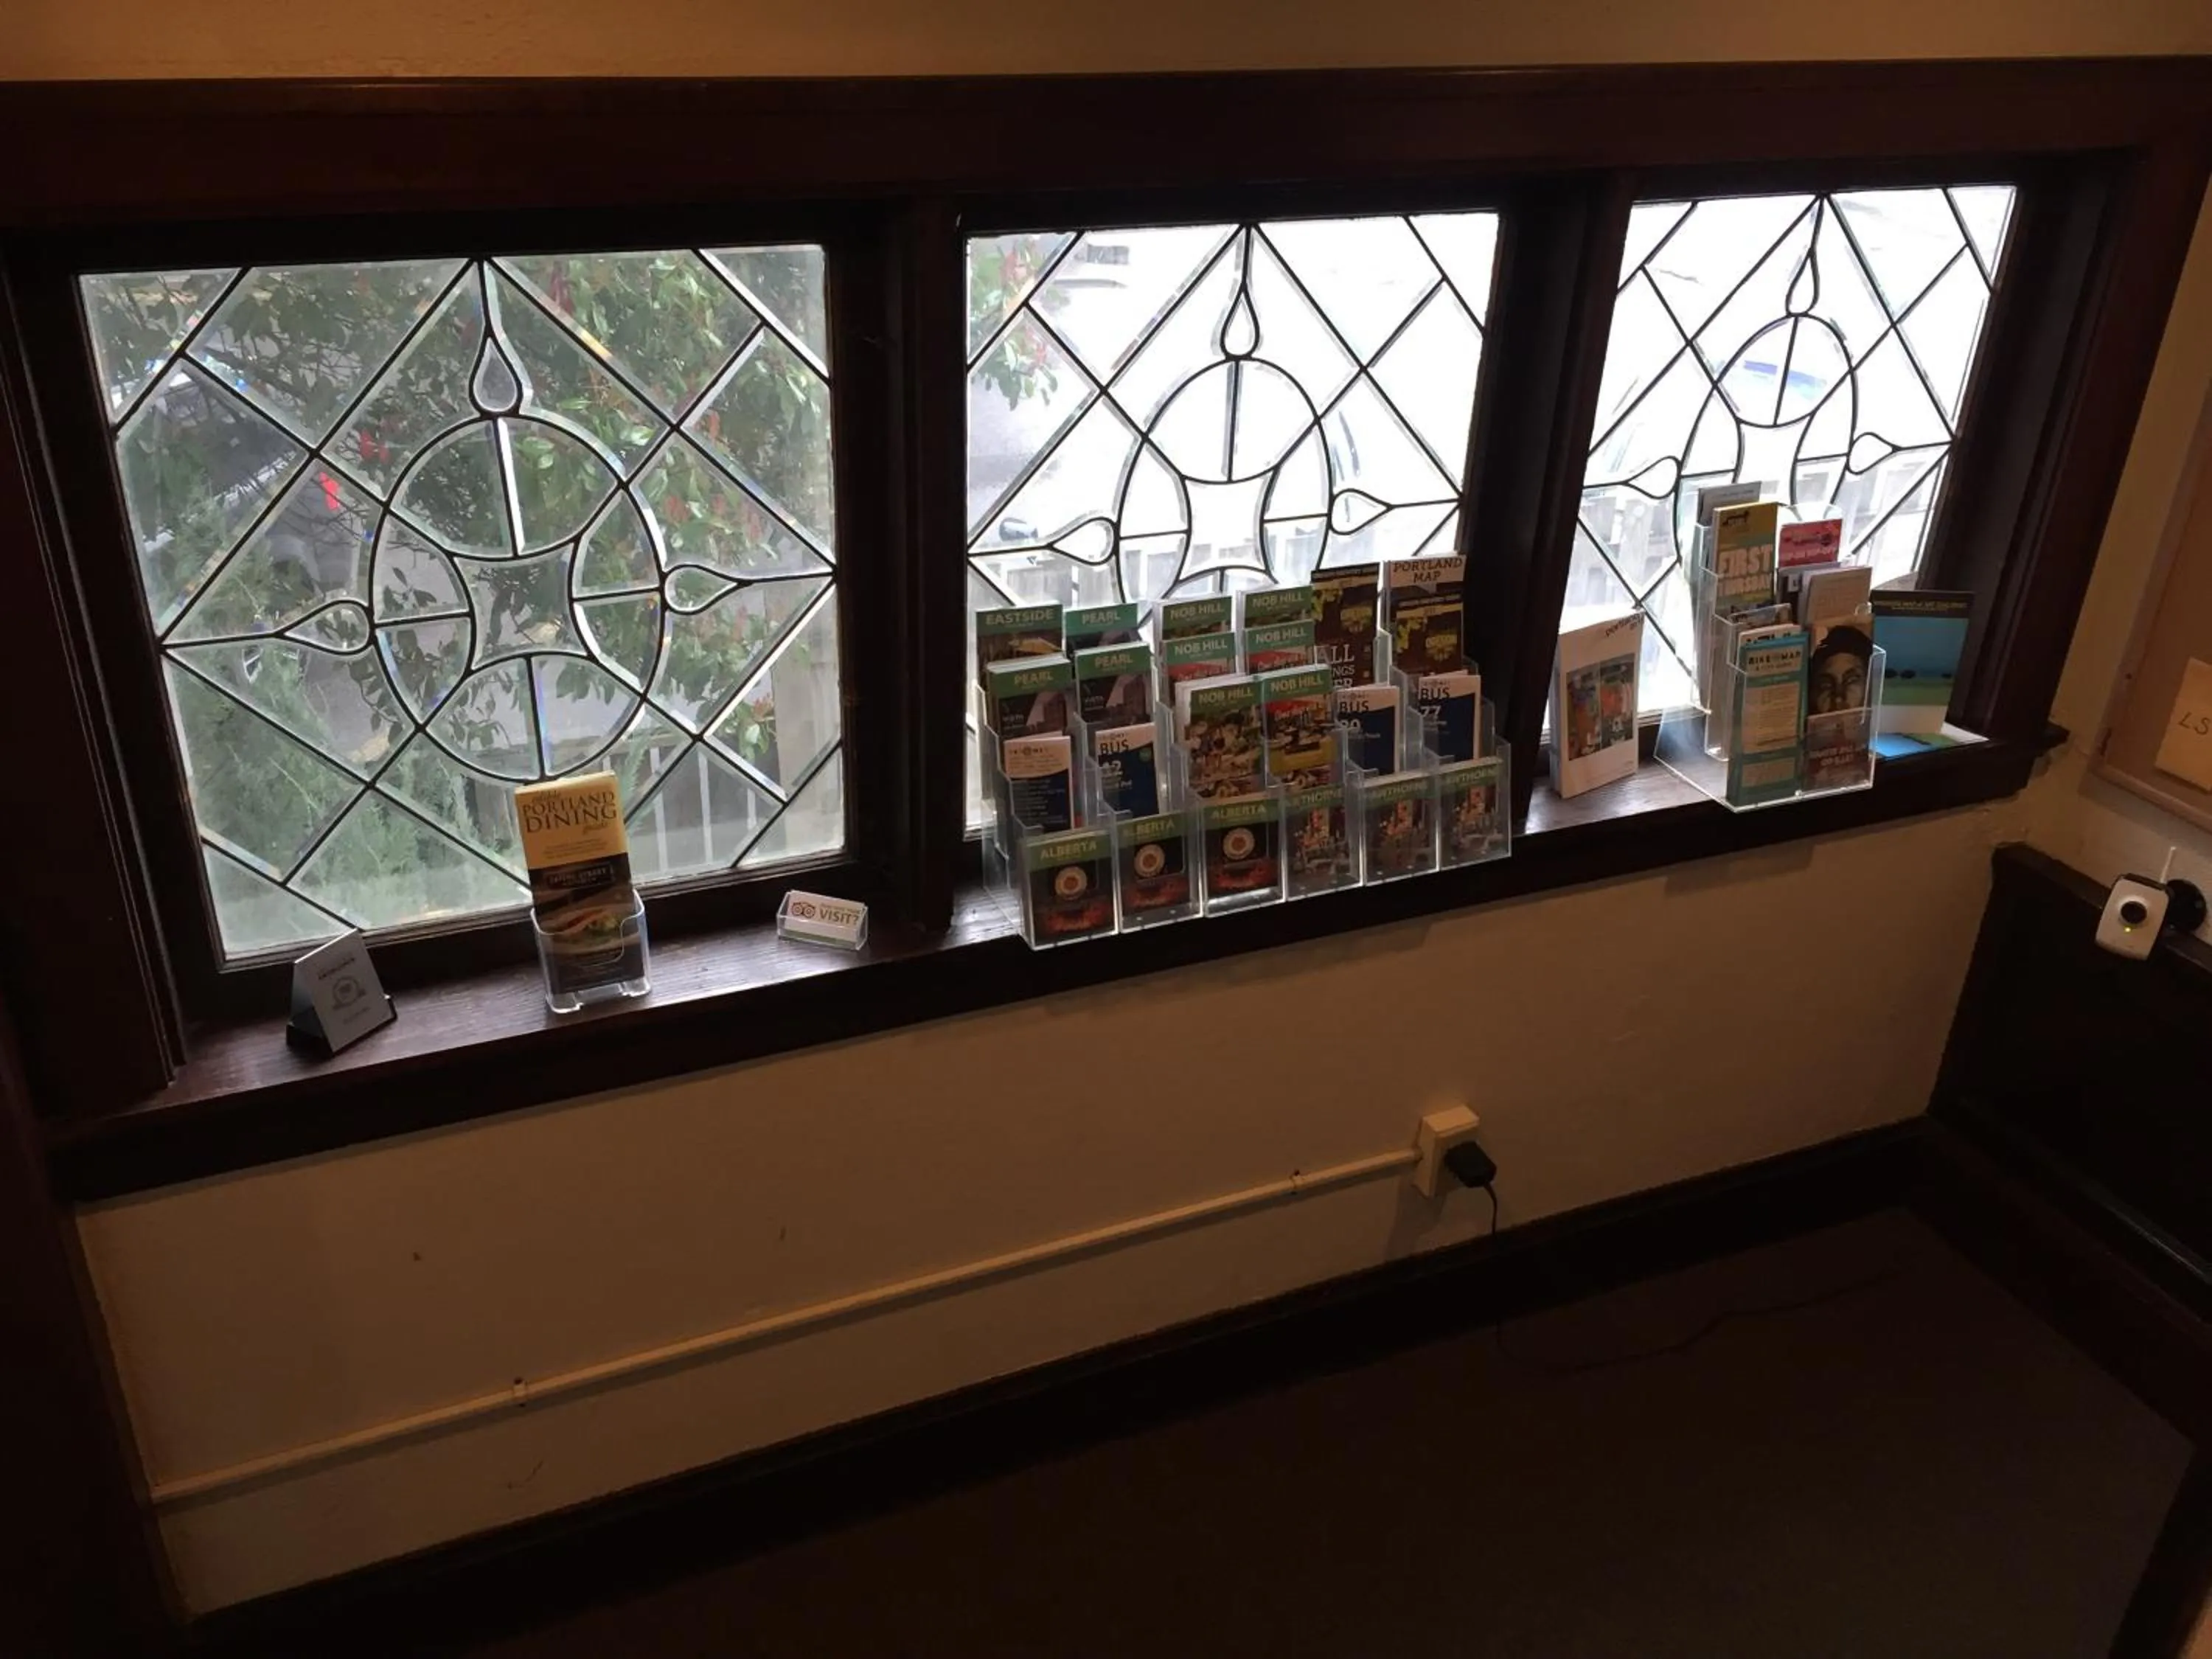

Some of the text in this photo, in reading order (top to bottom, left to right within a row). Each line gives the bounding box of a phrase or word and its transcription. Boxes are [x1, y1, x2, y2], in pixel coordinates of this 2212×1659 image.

[1393, 557, 1464, 573] PORTLAND
[1413, 571, 1441, 582] MAP
[1253, 591, 1304, 608] NOB HILL
[986, 609, 1054, 625] EASTSIDE
[1082, 611, 1121, 625] PEARL
[1170, 603, 1225, 619] NOB HILL
[1256, 625, 1307, 644] NOB HILL
[1175, 639, 1228, 655] NOB HILL
[1094, 653, 1133, 669] PEARL
[1014, 671, 1054, 686] PEARL
[1271, 675, 1324, 692] NOB HILL
[1199, 687, 1252, 704] NOB HILL
[1421, 687, 1450, 700] BUS
[1340, 700, 1369, 712] BUS
[1420, 706, 1441, 720] 77
[1100, 740, 1129, 754] BUS
[522, 791, 615, 816] PORTLAND
[1211, 804, 1267, 819] ALBERTA
[526, 803, 617, 834] DINING
[1122, 818, 1175, 835] ALBERTA
[1040, 841, 1097, 860] ALBERTA
